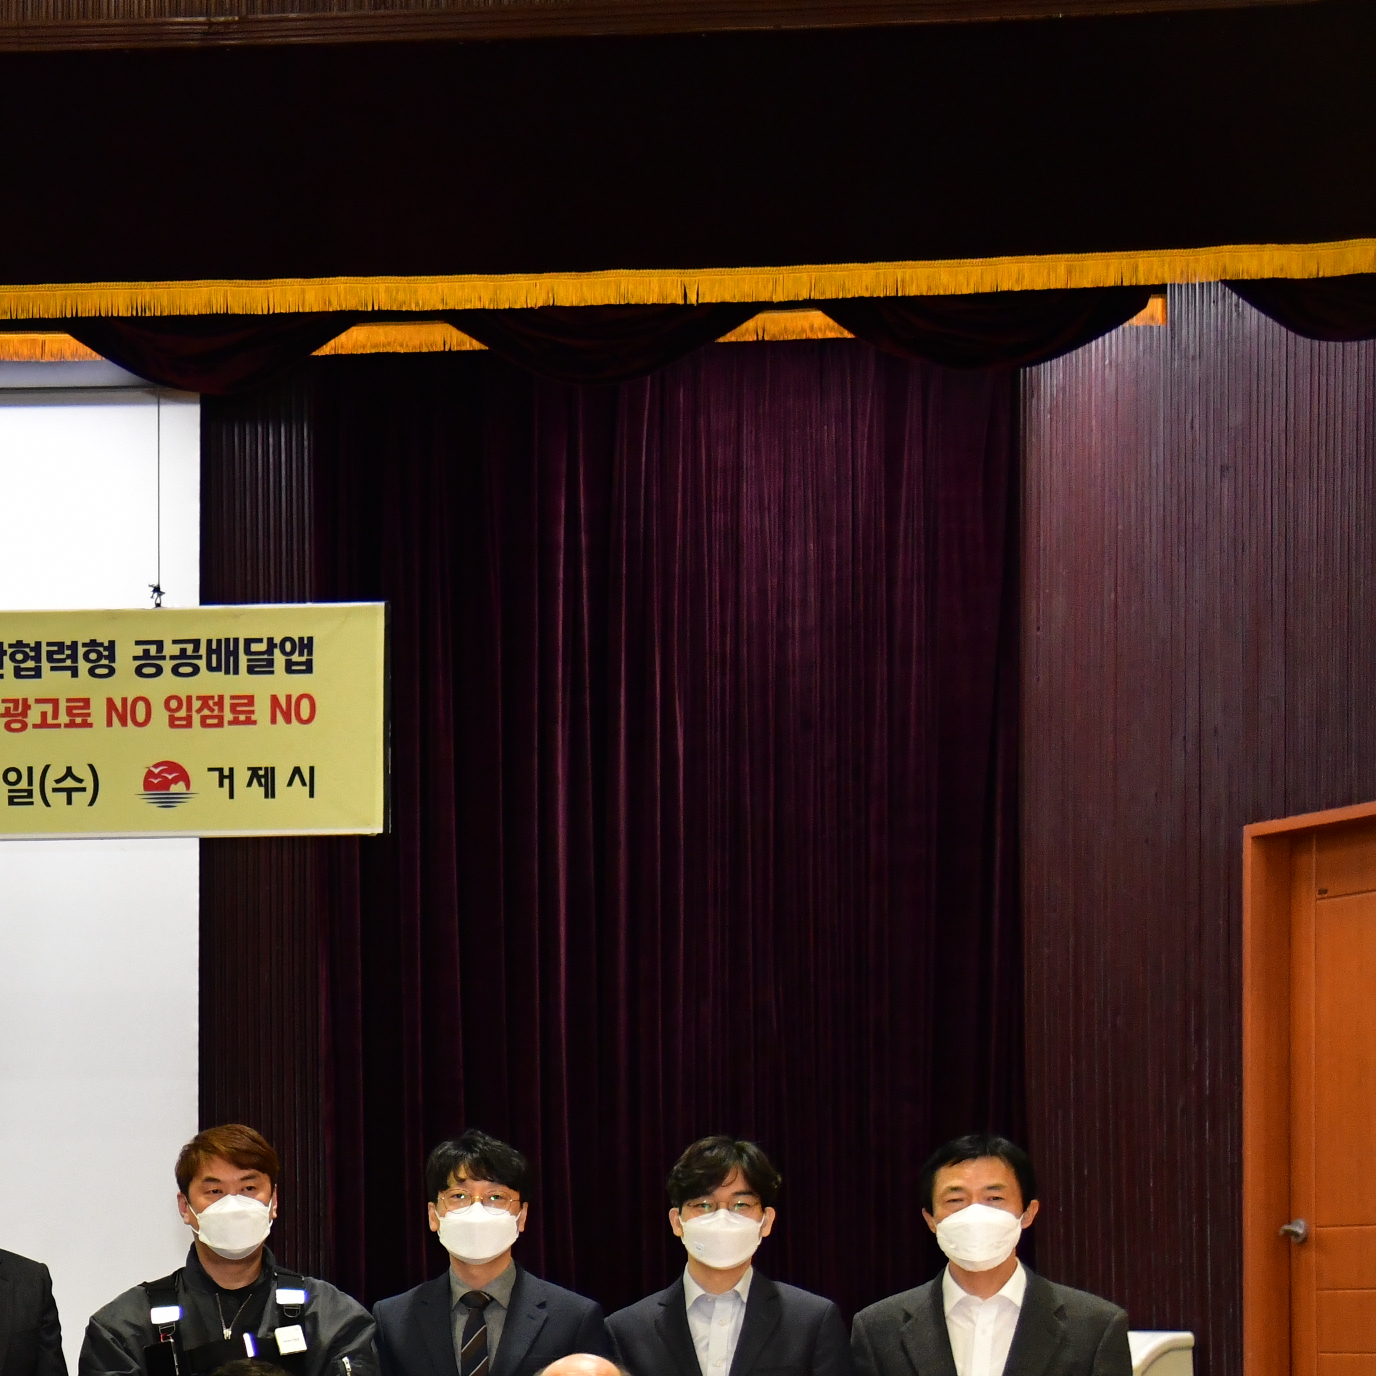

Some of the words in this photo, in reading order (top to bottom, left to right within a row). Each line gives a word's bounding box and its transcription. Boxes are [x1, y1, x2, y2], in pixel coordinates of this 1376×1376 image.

[132, 635, 315, 679] 공공배달앱
[0, 697, 92, 733] 광고료
[105, 695, 152, 729] NO
[164, 693, 258, 730] 입점료
[269, 692, 316, 726] NO
